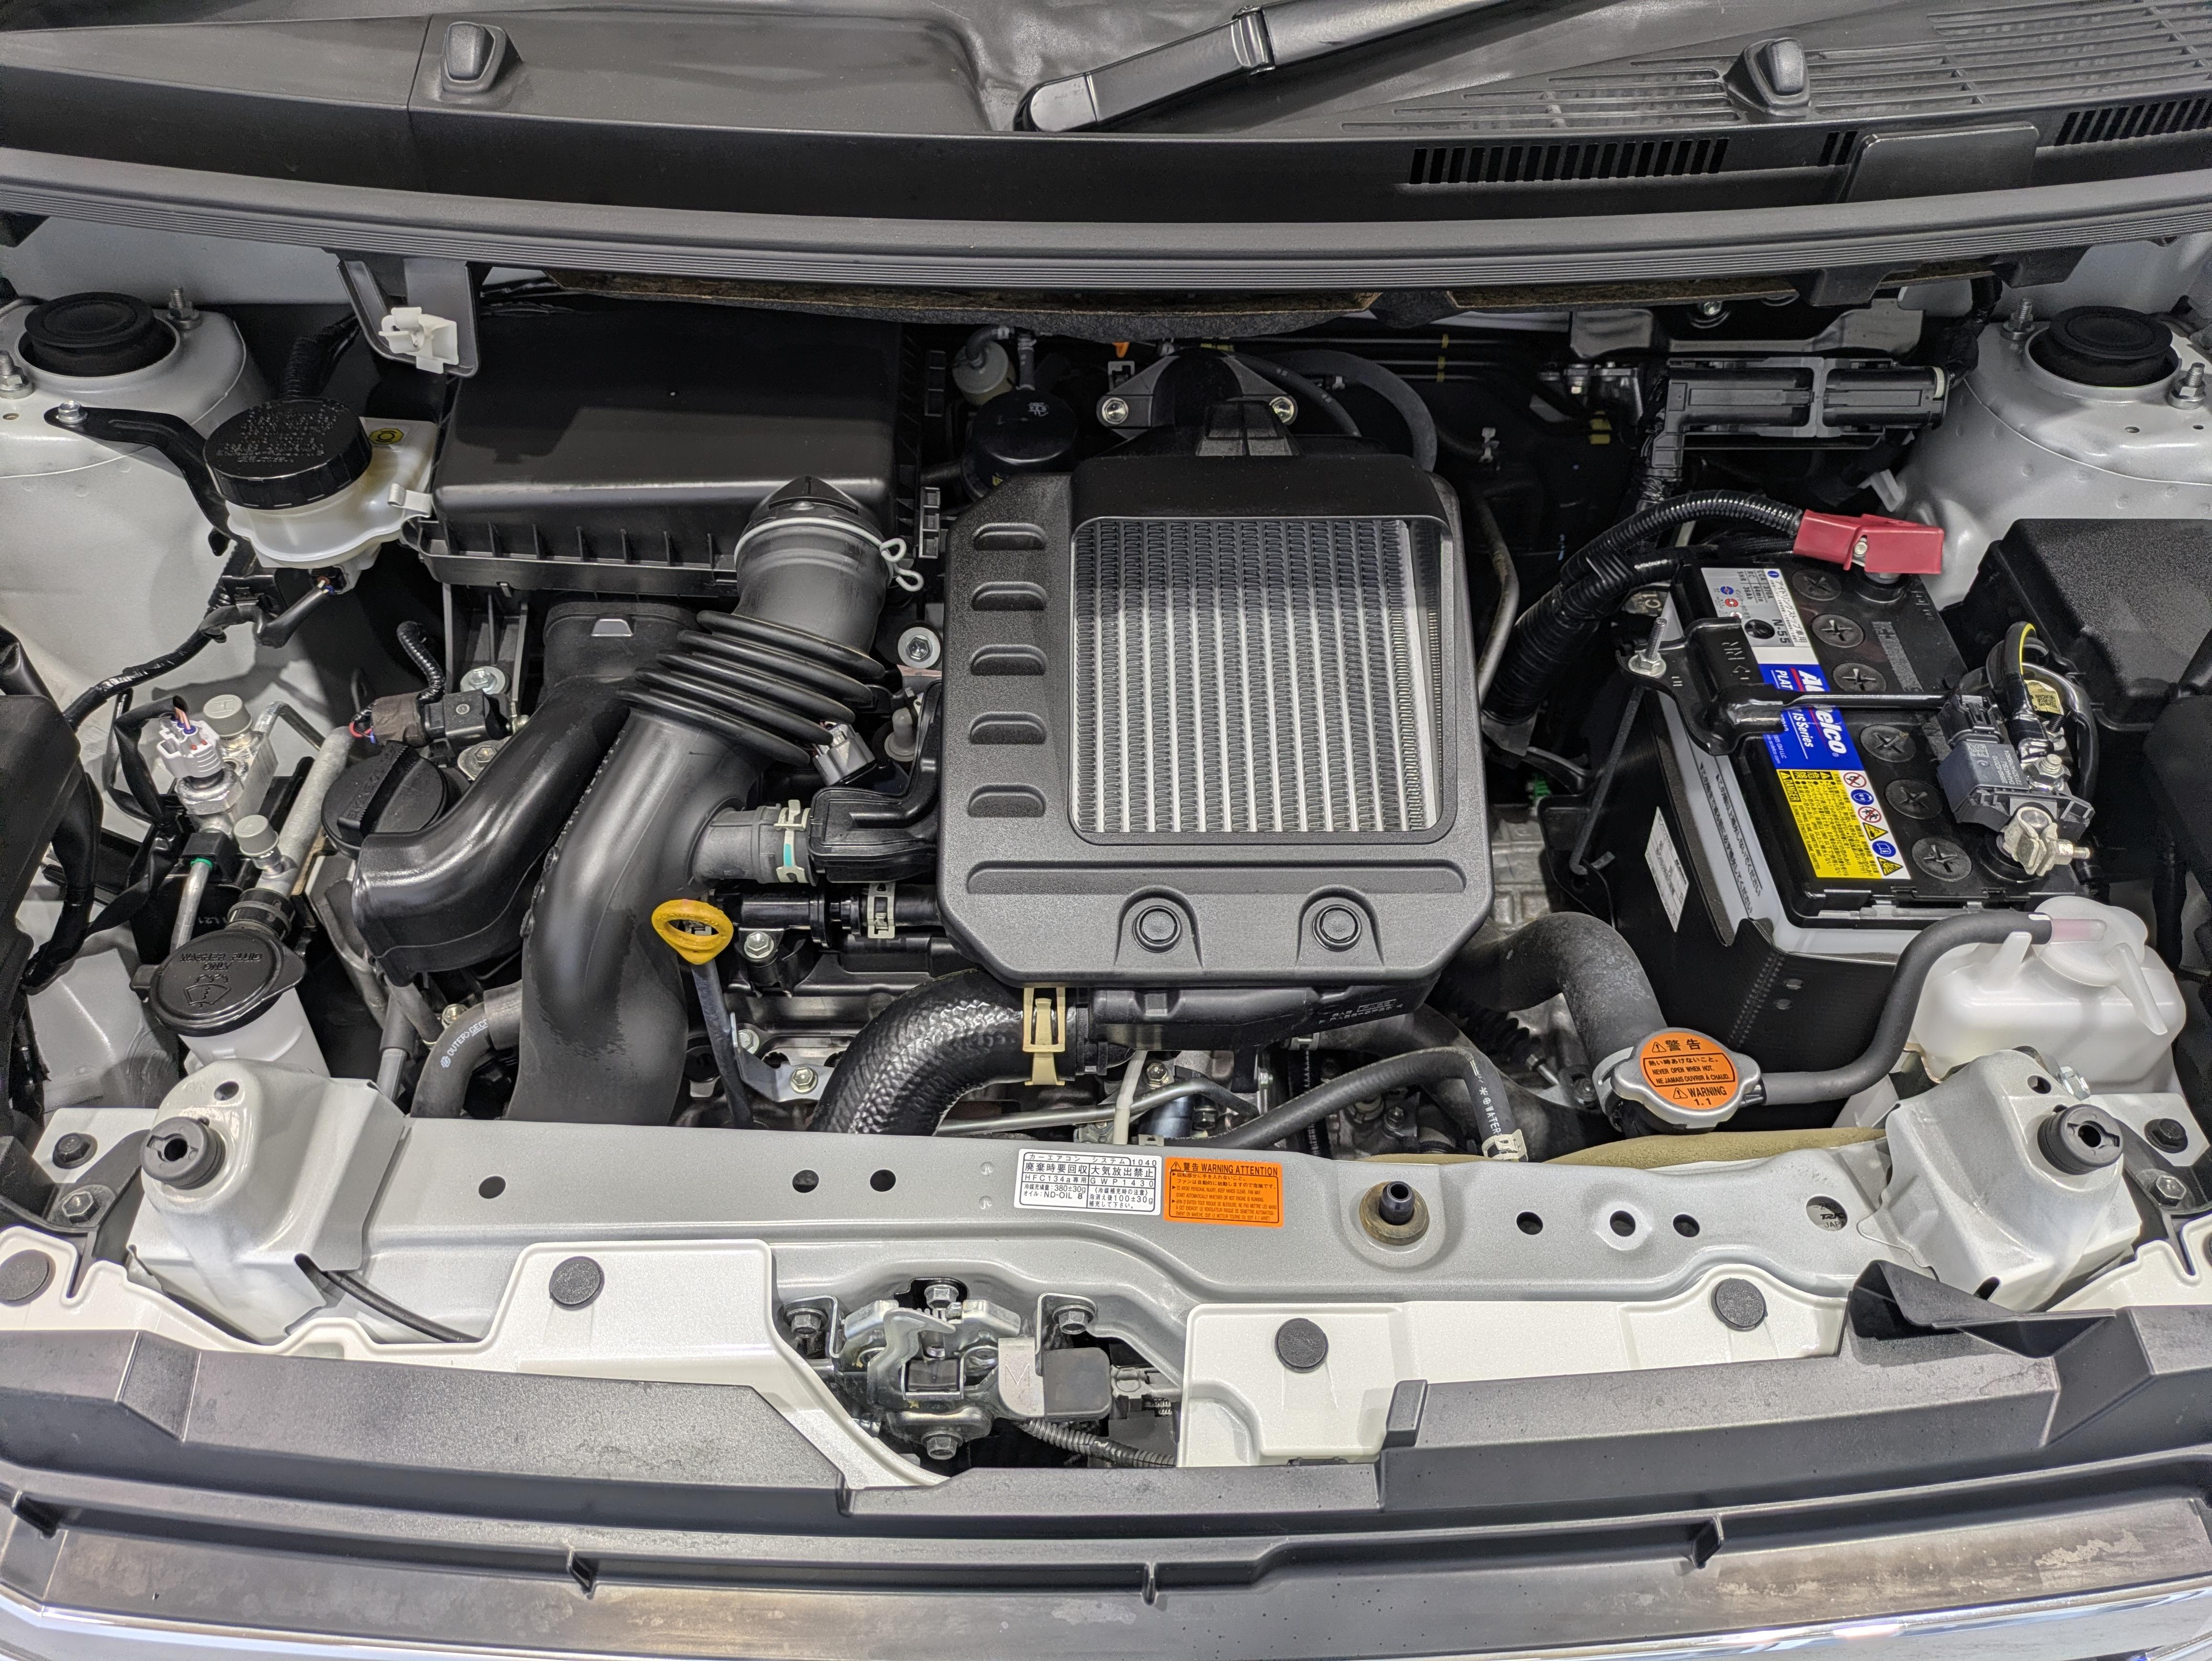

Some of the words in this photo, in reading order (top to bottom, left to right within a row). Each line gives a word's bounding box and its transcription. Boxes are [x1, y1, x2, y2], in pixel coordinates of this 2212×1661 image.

[1756, 571, 1766, 580] CCA
[1763, 586, 1774, 598] 370A
[1752, 586, 1765, 601] 64min
[1774, 581, 1808, 642] アイドリングストップ車用
[1782, 779, 1800, 800] DANGER
[180, 952, 226, 962] WASHER
[230, 952, 262, 962] FLUID
[202, 962, 232, 971] ONLY
[1665, 1039, 1701, 1051] 警告
[1648, 1056, 1718, 1066] 熱い時あけないこと。
[1687, 1086, 1727, 1097] WARNING
[1025, 1163, 1087, 1174] 廃棄時要回収
[1091, 1165, 1154, 1178] 大気放出禁止
[1183, 1162, 1198, 1171] 警告
[1201, 1163, 1233, 1173] WARNING
[1236, 1164, 1277, 1176] ATTENTION
[1025, 1174, 1086, 1184] HFC134a専用
[1177, 1172, 1246, 1181] 回転部分に手を入れないこと。
